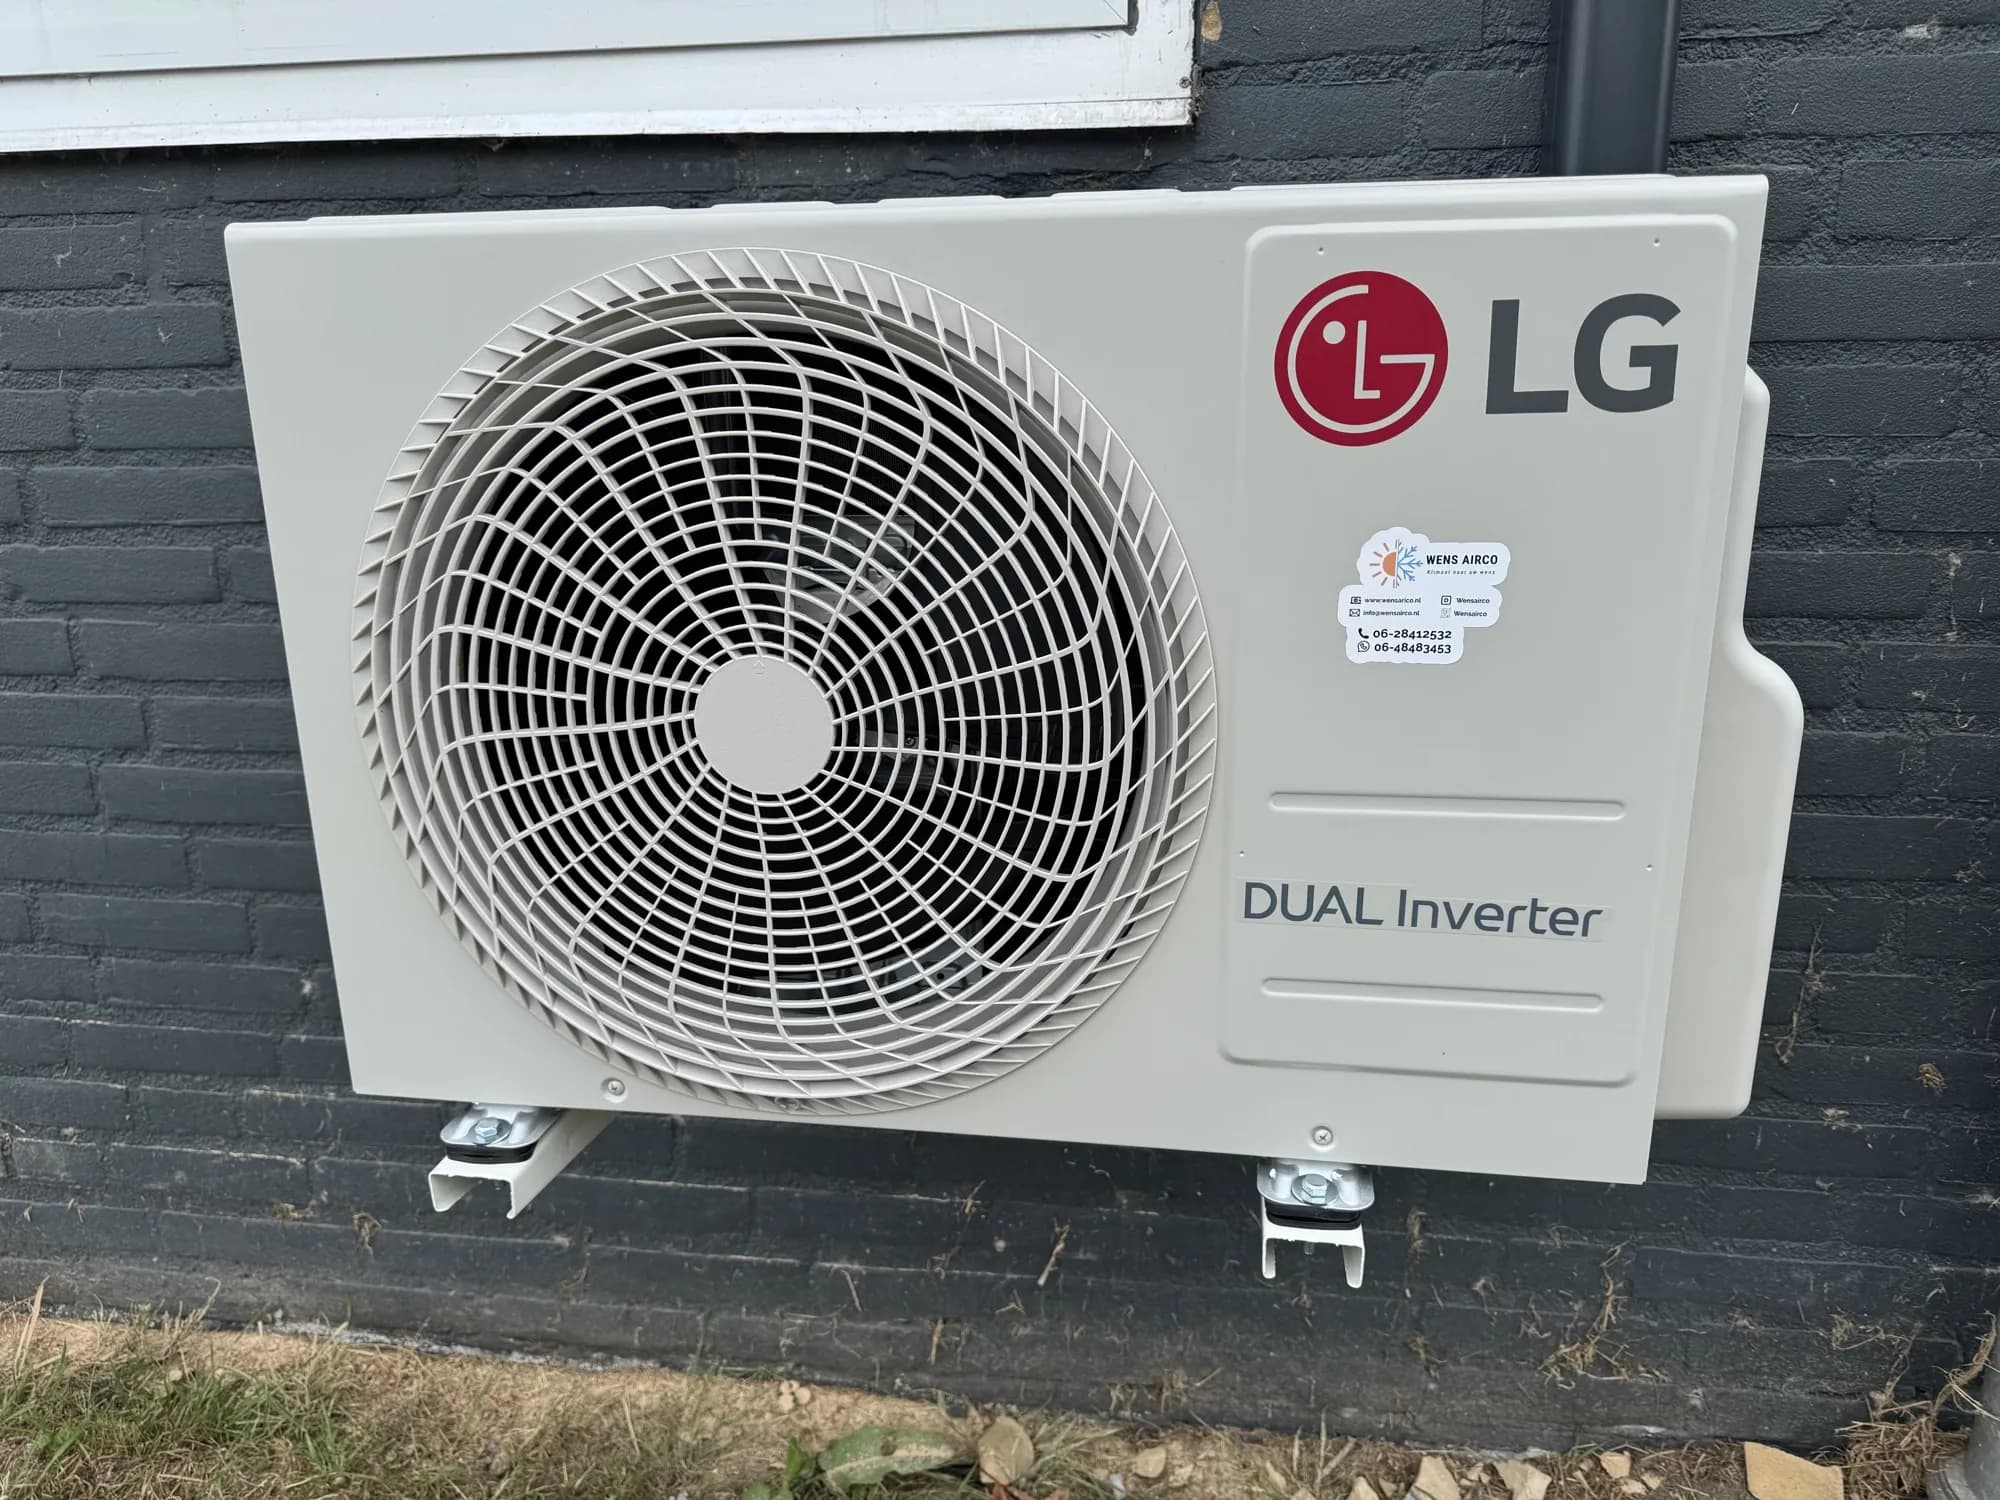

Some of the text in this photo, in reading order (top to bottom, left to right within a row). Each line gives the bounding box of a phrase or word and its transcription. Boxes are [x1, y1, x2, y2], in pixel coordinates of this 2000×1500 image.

[1486, 293, 1681, 414] LG
[1426, 554, 1498, 565] WENS AIRCO
[1363, 609, 1420, 617] info@wensairco.nl
[1372, 628, 1452, 640] 06-28412532
[1374, 642, 1452, 654] 06-48483453
[1244, 881, 1603, 937] DUAL Inverter
